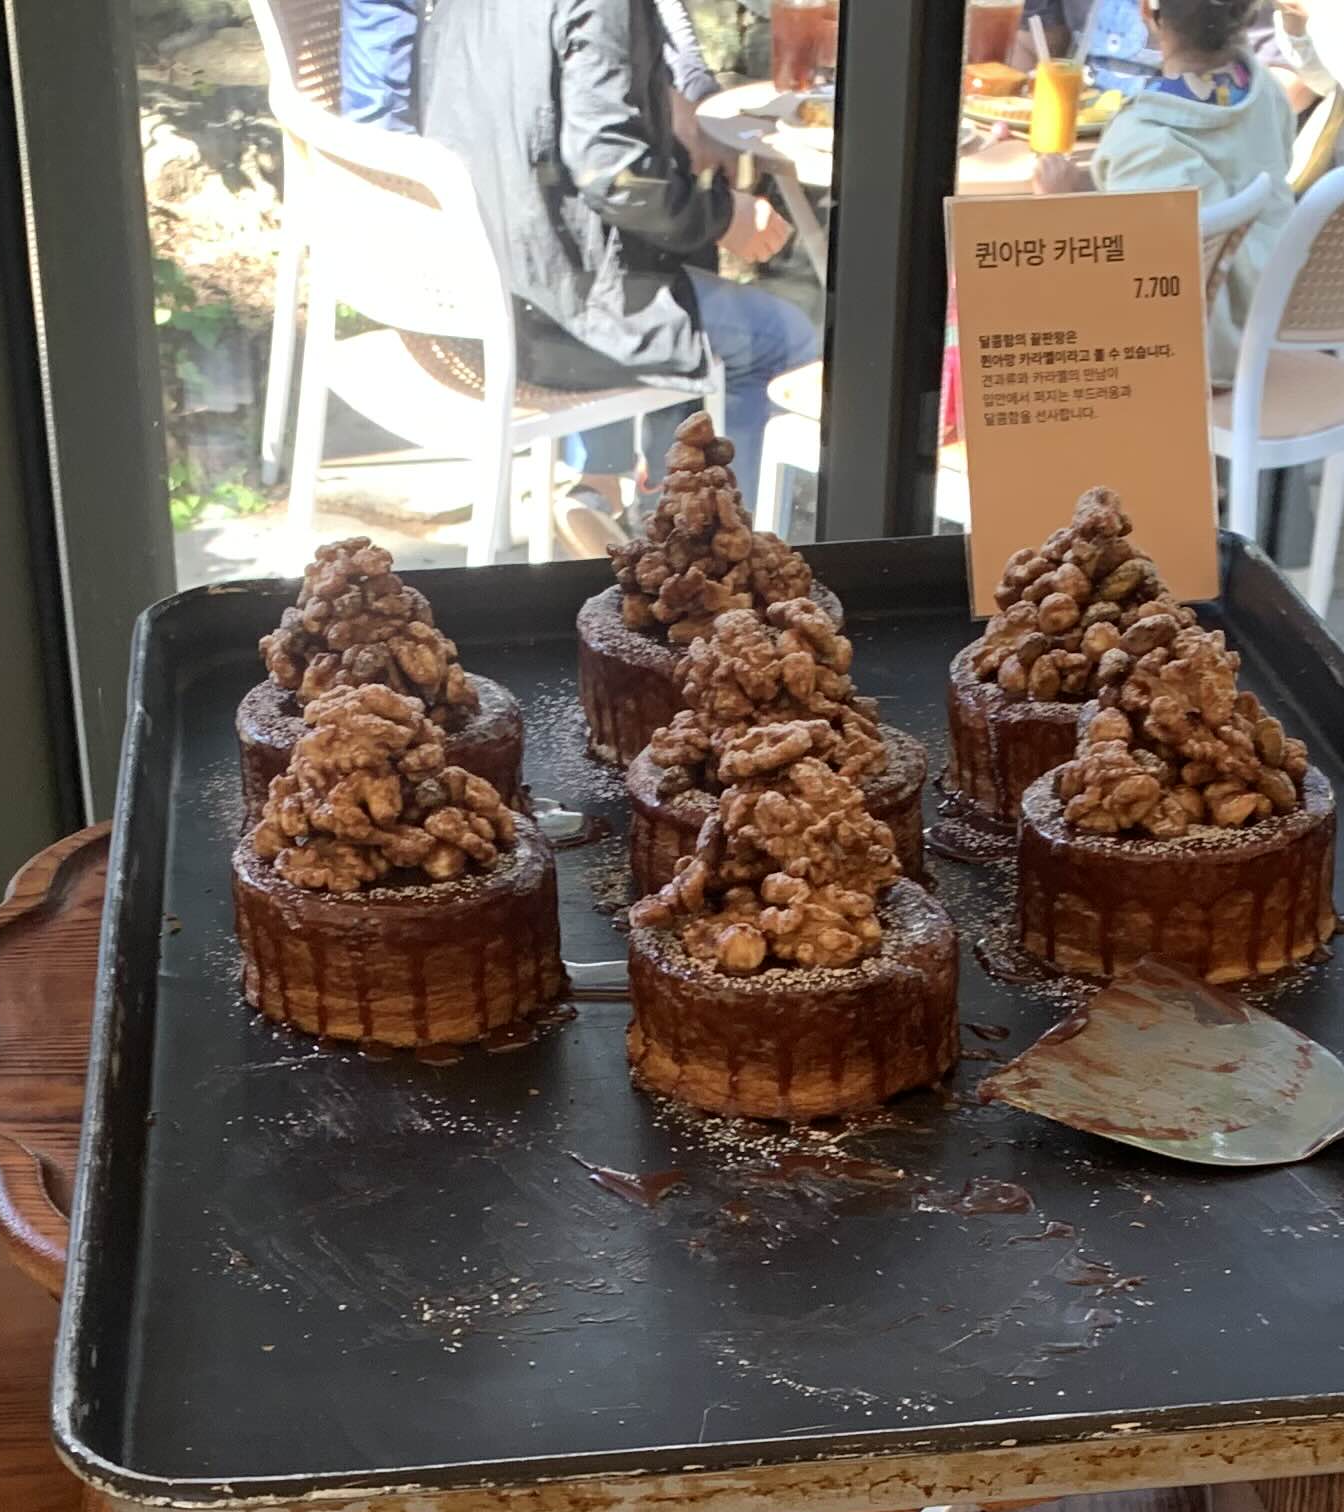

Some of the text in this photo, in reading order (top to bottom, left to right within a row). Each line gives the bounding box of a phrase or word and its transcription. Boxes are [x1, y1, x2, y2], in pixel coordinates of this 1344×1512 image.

[975, 234, 1125, 269] 퀸아망 카라멜
[1133, 275, 1181, 299] 7.700
[980, 353, 1016, 369] 퀸아망
[1019, 348, 1090, 366] 카라멜이라고
[1109, 347, 1120, 361] 수
[1123, 343, 1176, 360] 있습니다.
